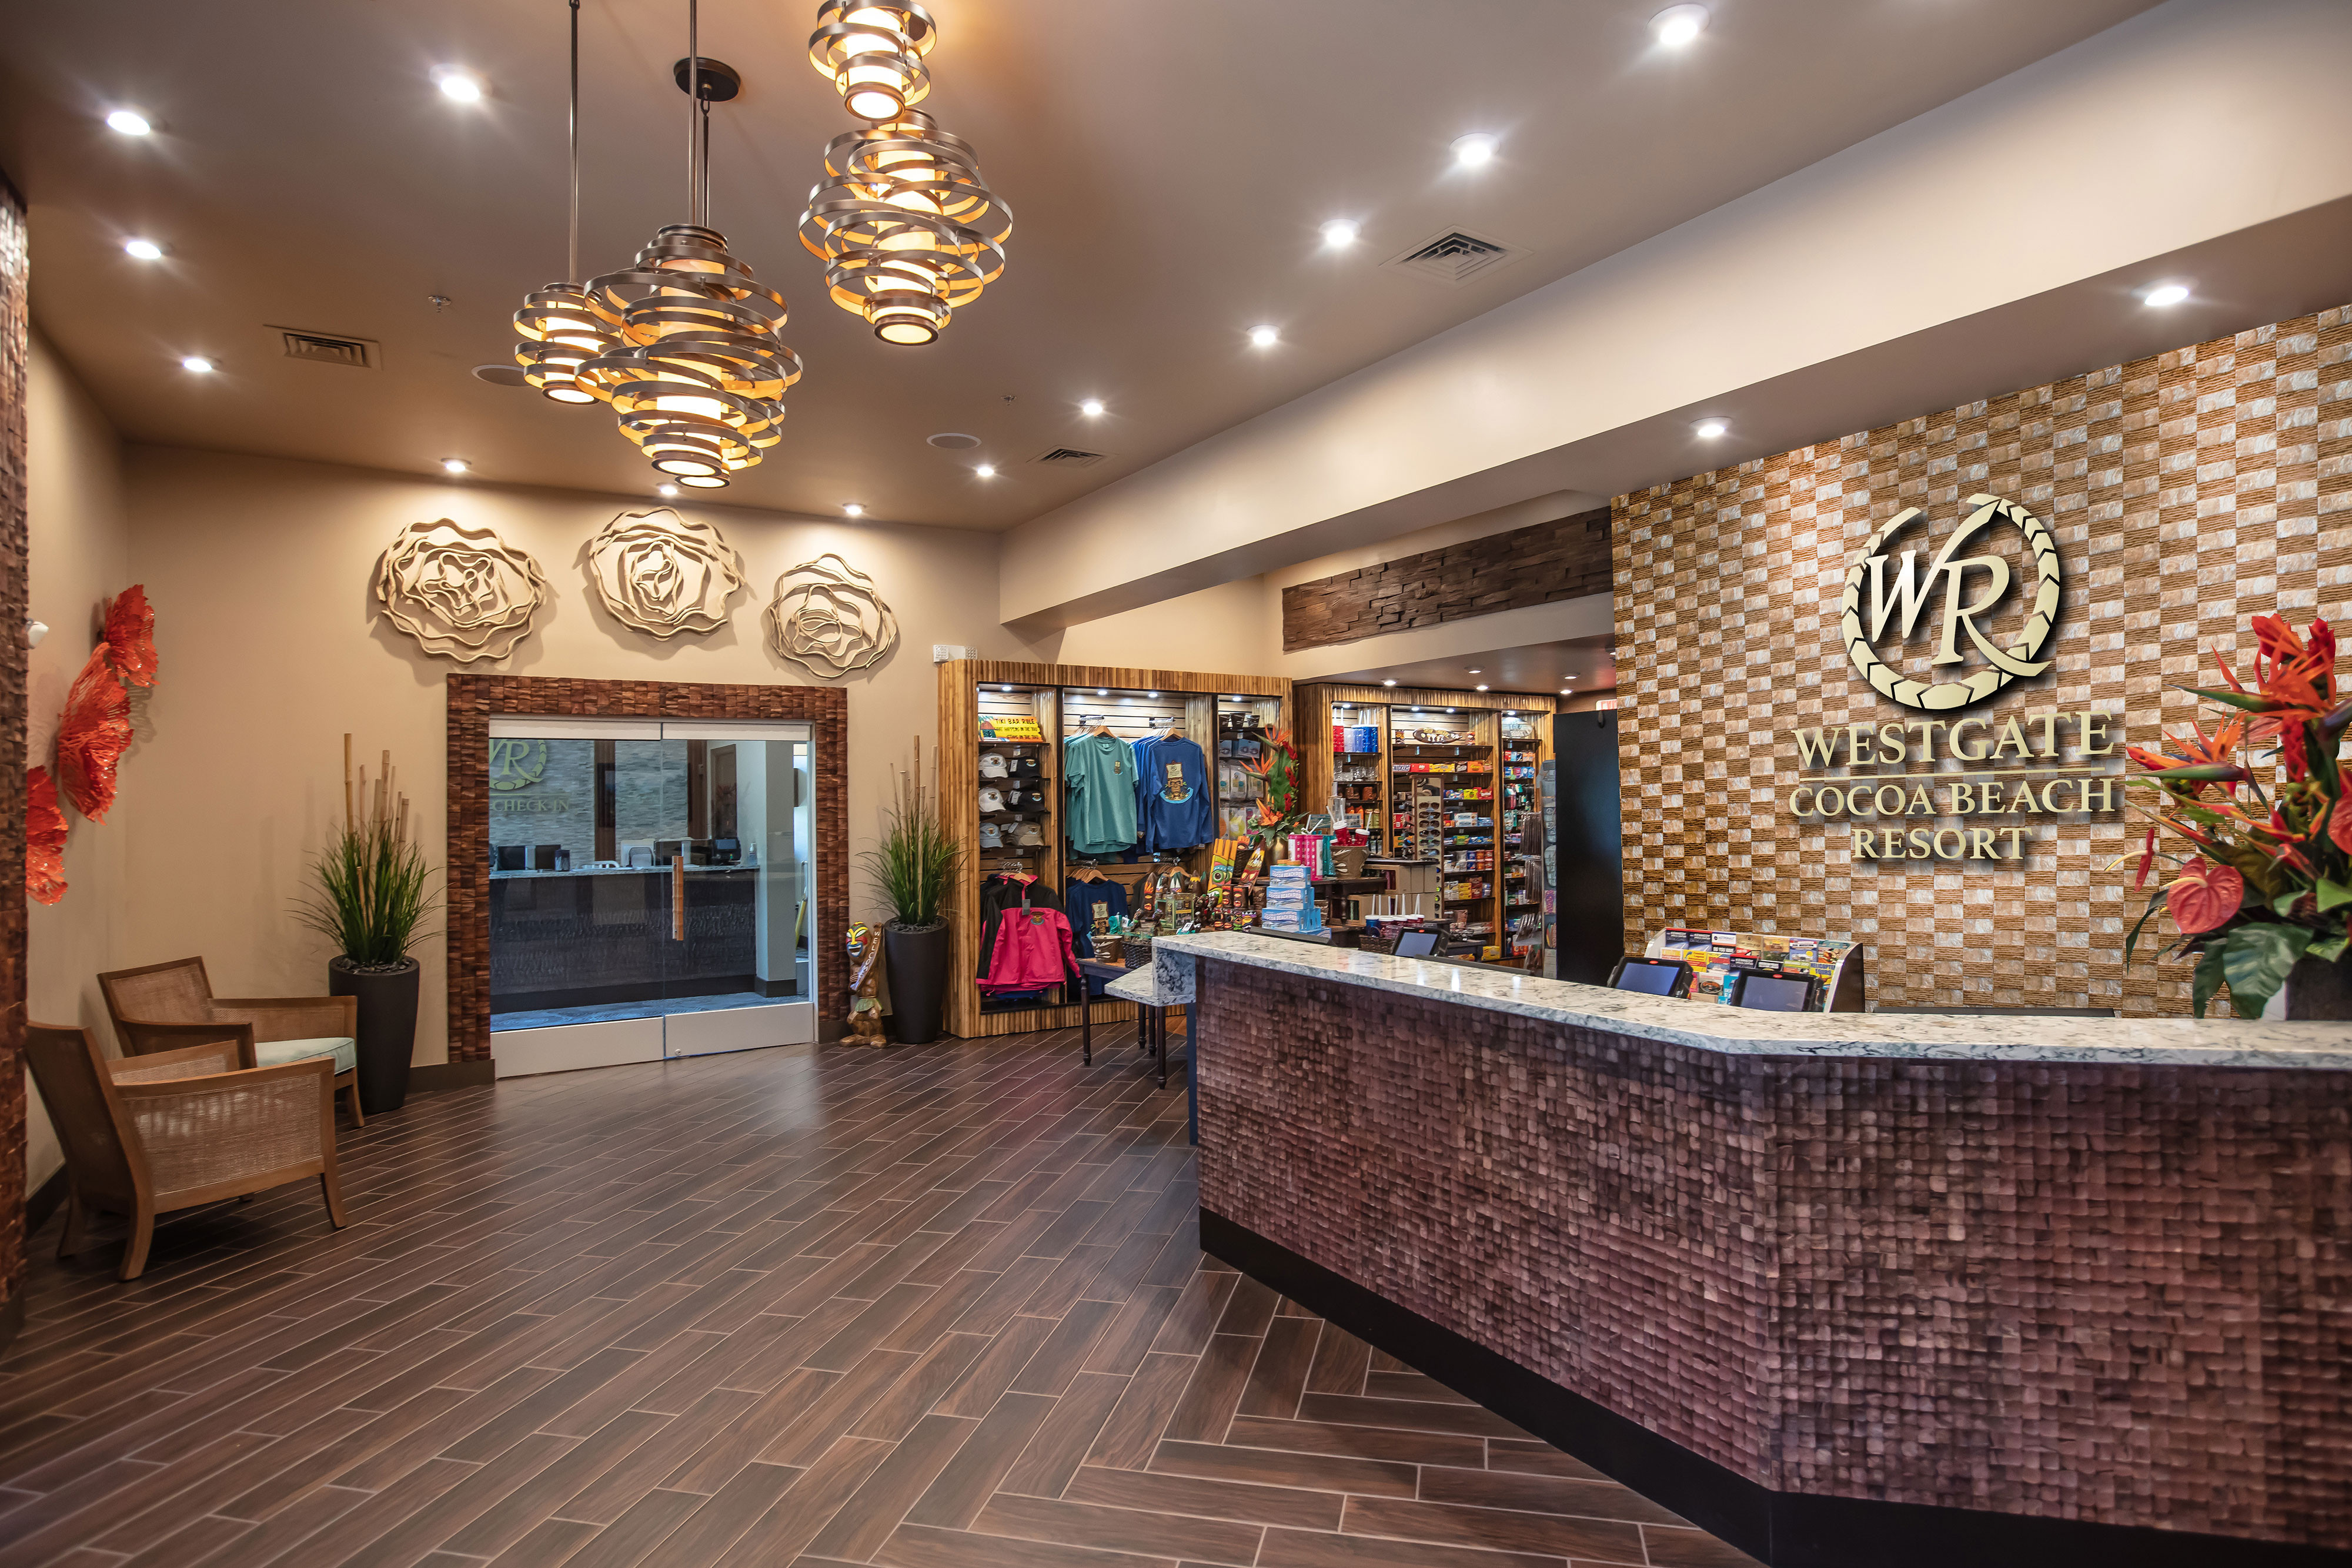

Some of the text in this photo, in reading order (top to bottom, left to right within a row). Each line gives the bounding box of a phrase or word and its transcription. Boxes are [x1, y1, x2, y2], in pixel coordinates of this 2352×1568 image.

[1791, 709, 2115, 768] WESTGATE
[493, 799, 570, 812] CHECK-IN
[1789, 777, 2116, 817] COCOA BEACH
[1851, 827, 2032, 860] RESORT
[858, 931, 880, 978] WELCOME
